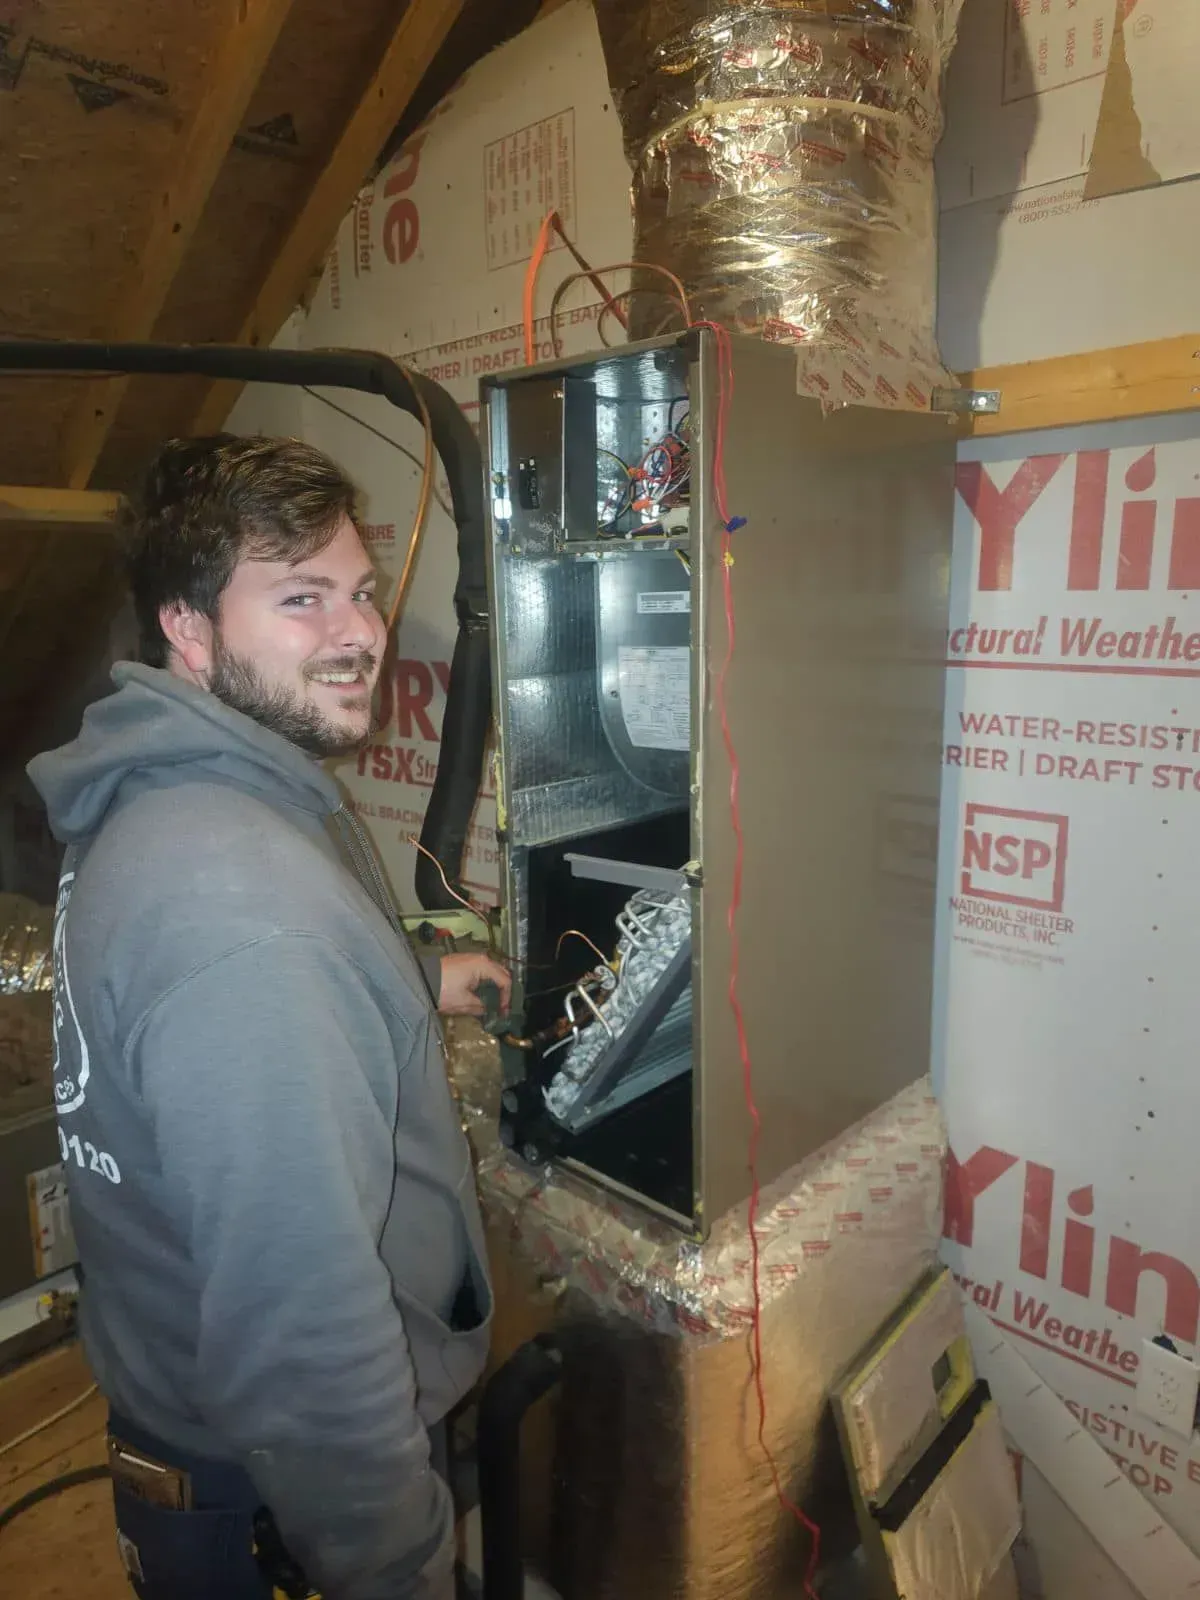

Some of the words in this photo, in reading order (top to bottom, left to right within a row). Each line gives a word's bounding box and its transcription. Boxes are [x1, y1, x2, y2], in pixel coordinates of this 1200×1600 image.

[472, 347, 521, 376] DRAFT
[524, 337, 565, 362] TOP
[1035, 753, 1144, 786] DRAFT
[962, 829, 1051, 880] NSP
[948, 896, 1013, 921] NATIONAL
[1015, 909, 1075, 934] SHELTER
[1013, 1287, 1140, 1374] Weathe
